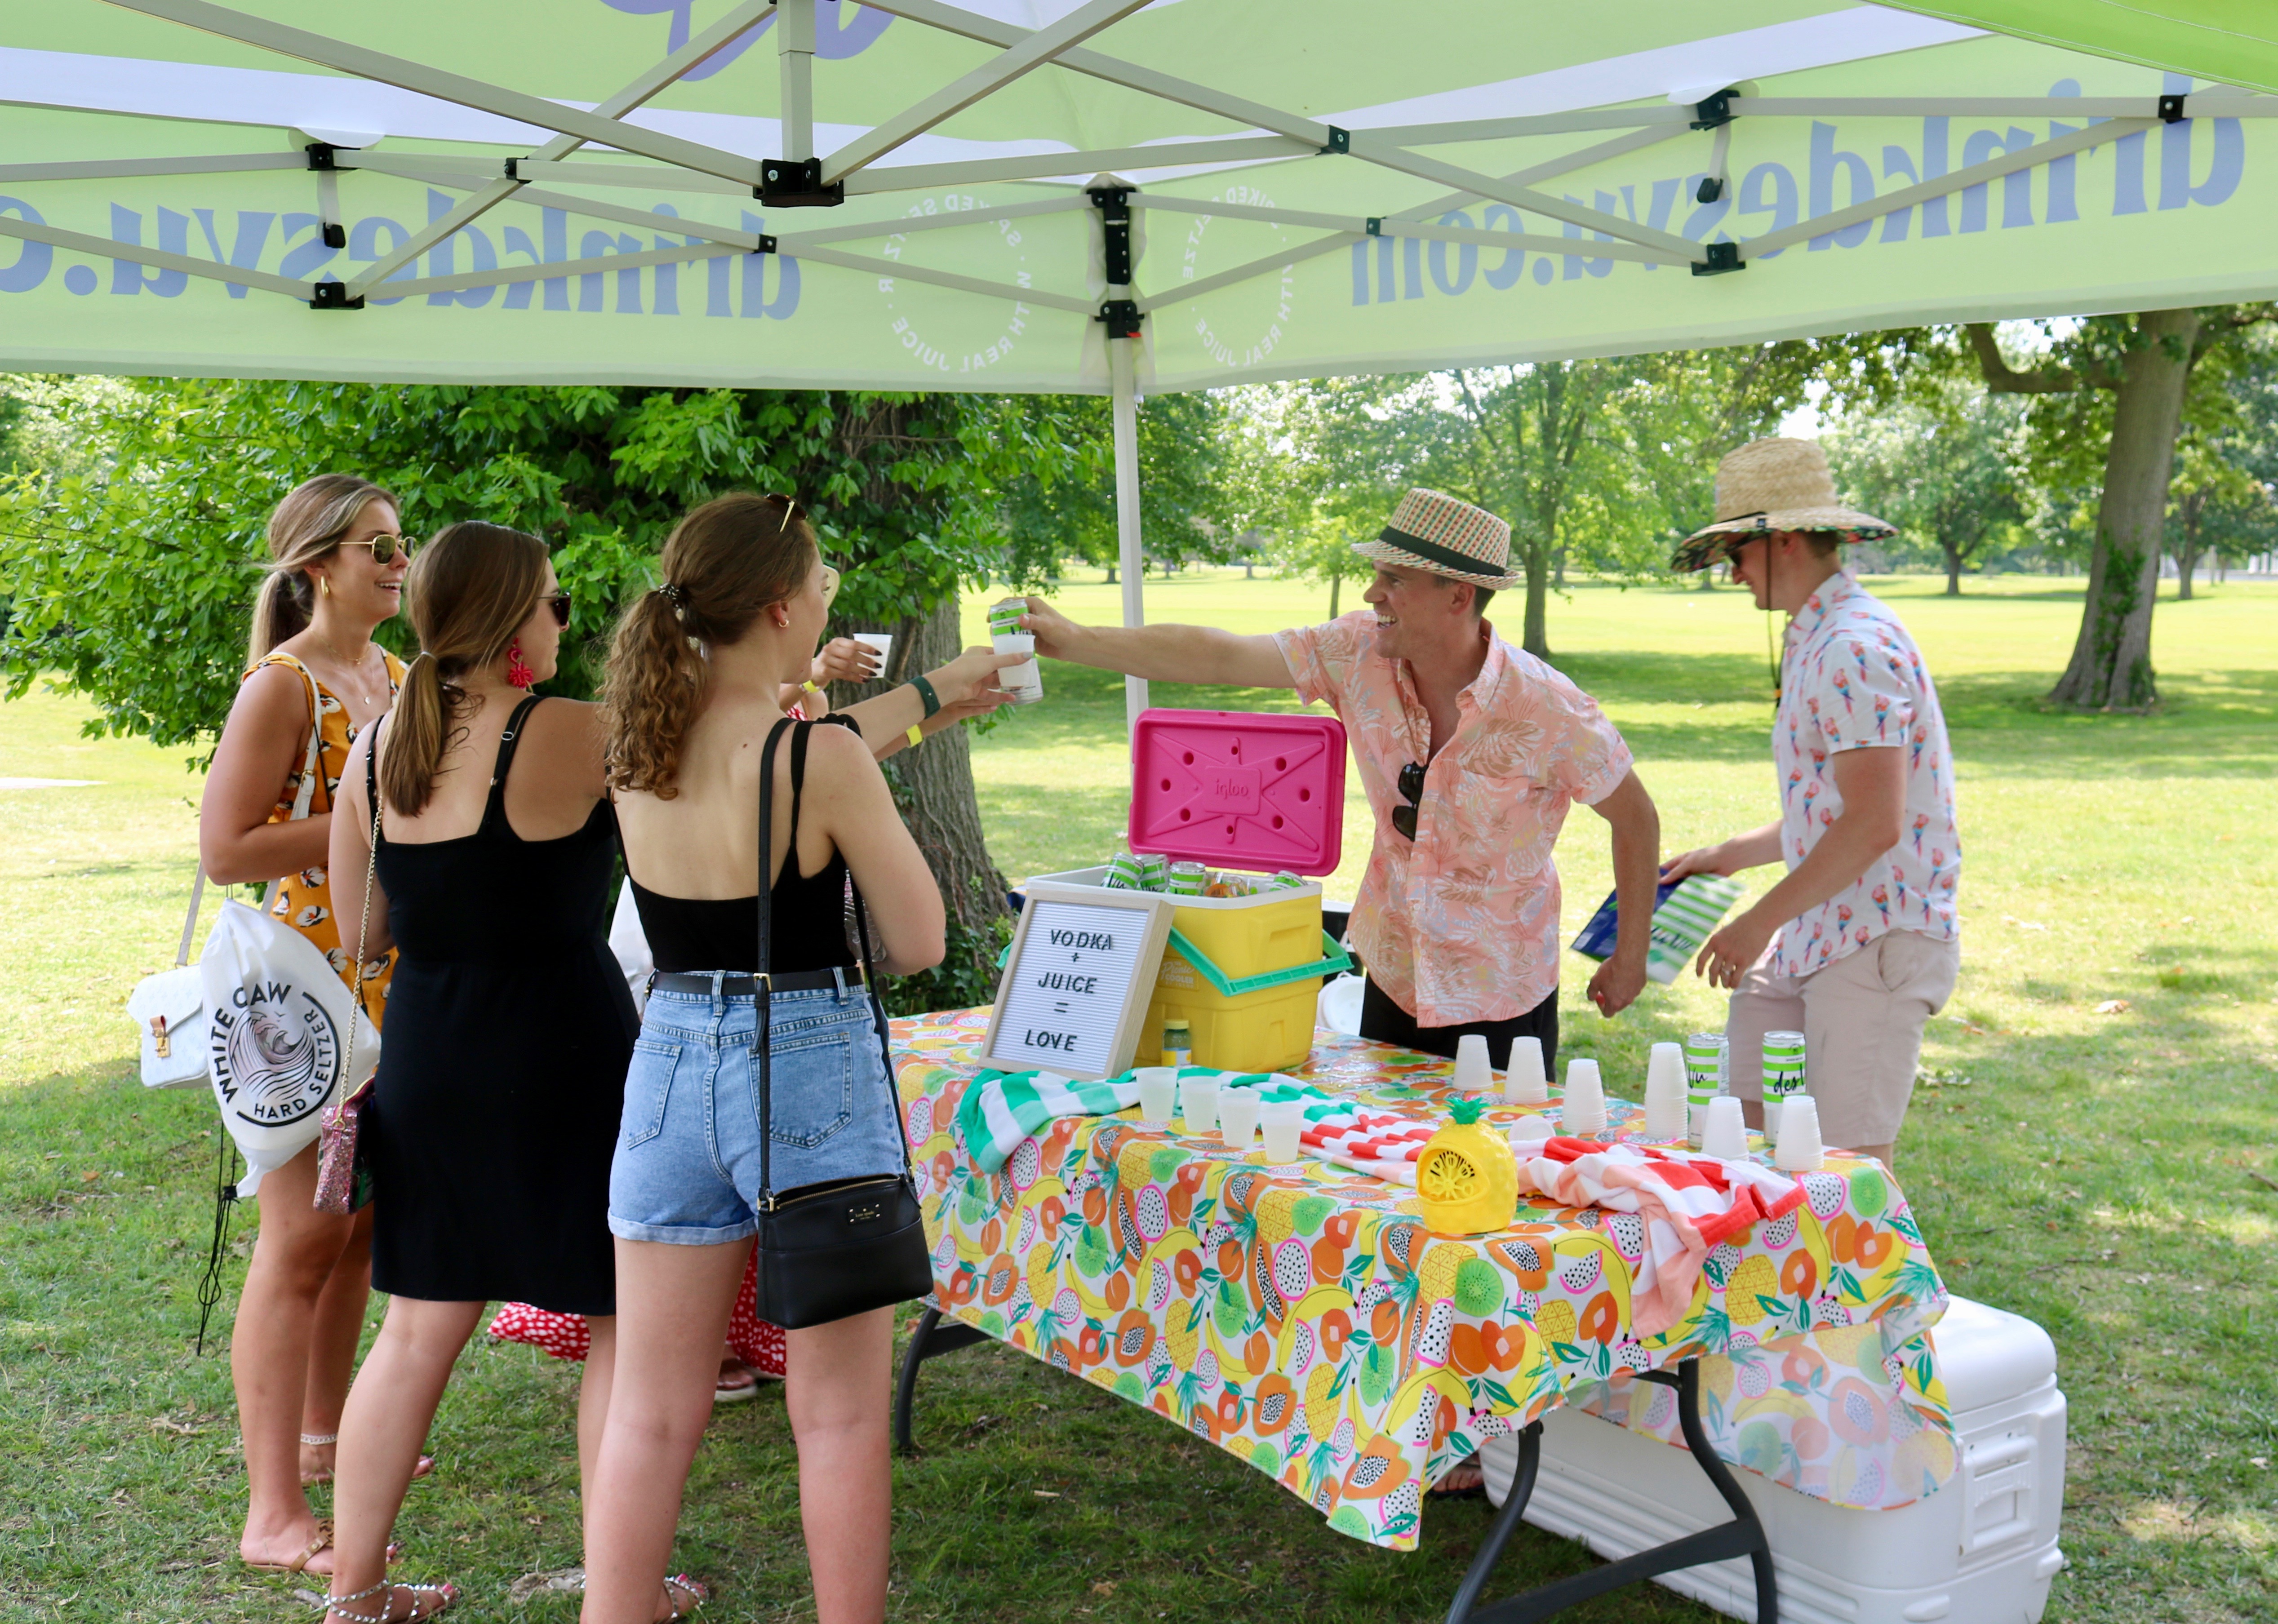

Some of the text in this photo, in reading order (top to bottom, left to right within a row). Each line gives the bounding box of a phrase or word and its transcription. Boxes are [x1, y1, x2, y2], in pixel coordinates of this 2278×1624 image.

[1215, 778, 1248, 800] igloo
[1051, 929, 1112, 950] VODKA
[1038, 972, 1097, 994] JUICE
[1165, 974, 1194, 985] COOLER
[1025, 1029, 1077, 1052] LOVE
[211, 1007, 239, 1105] WHITE
[254, 1008, 332, 1119] HARD SELTZER
